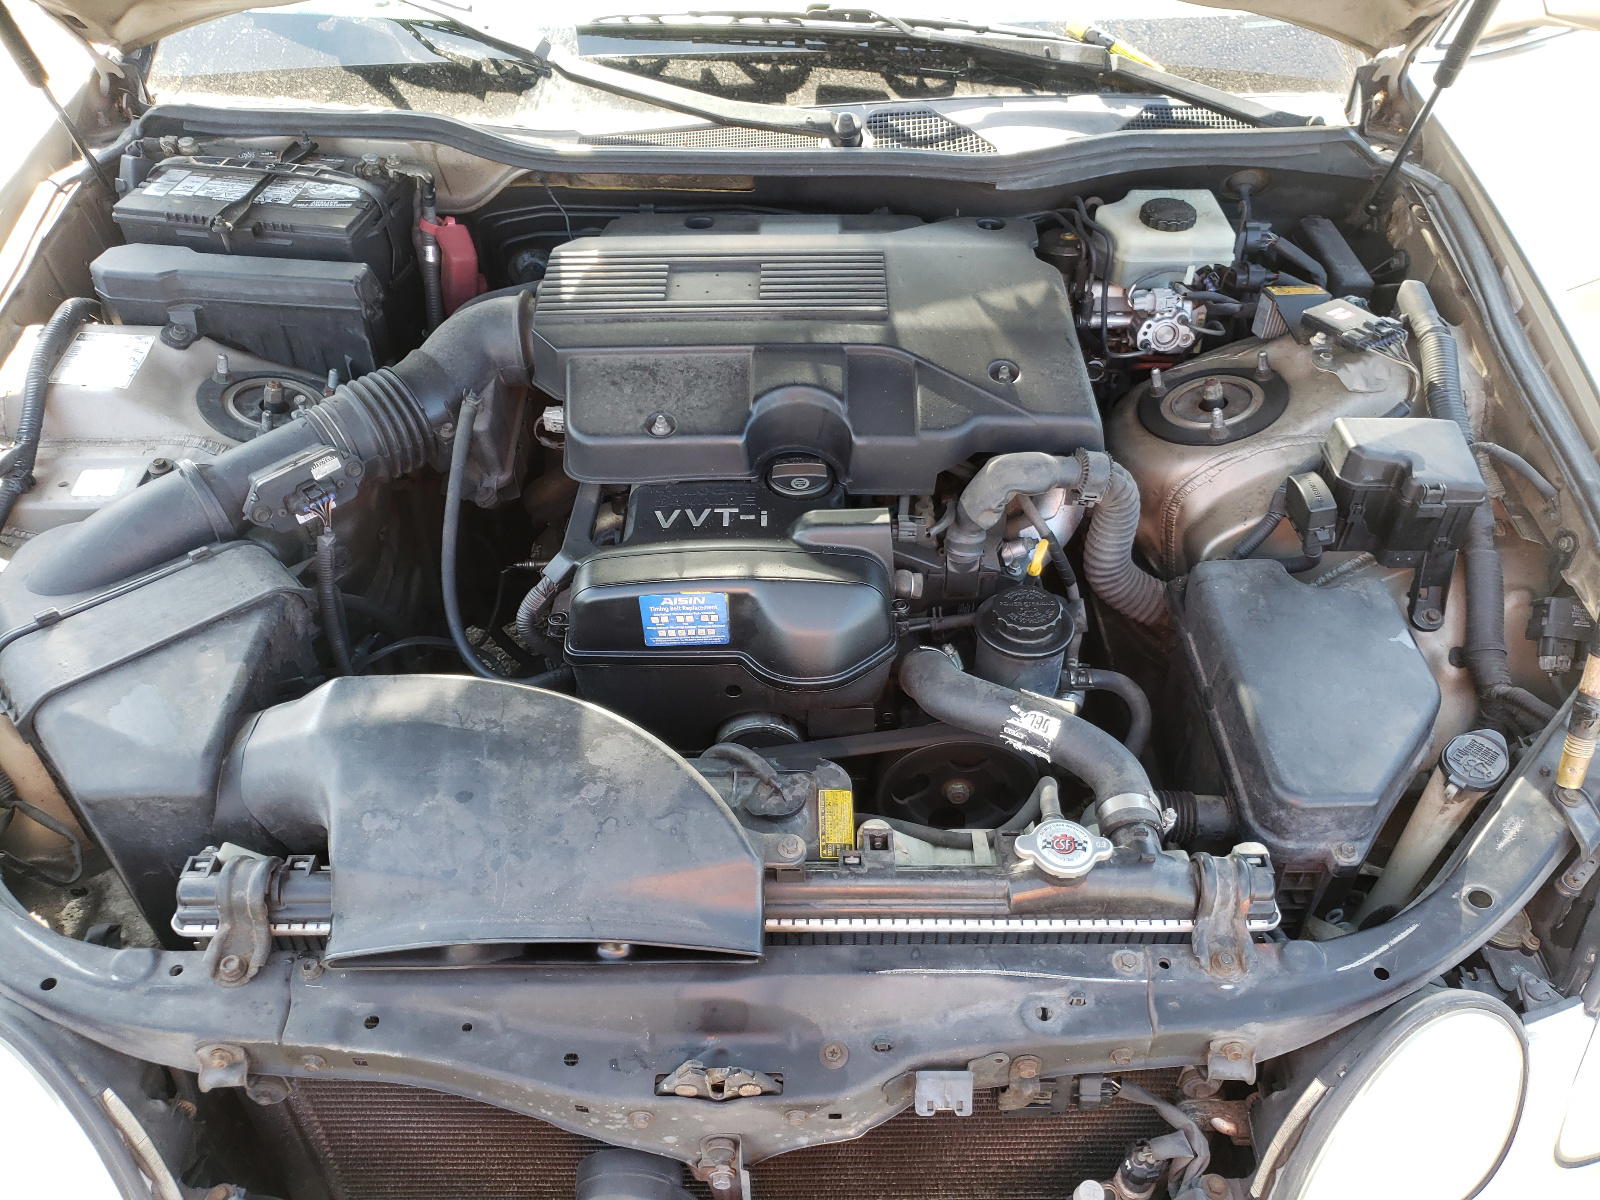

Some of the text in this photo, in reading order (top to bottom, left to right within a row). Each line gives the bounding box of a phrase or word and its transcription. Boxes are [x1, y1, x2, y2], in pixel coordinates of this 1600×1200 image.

[654, 507, 768, 529] VVT-i
[660, 596, 706, 606] AISIN
[1053, 839, 1073, 850] CSF
